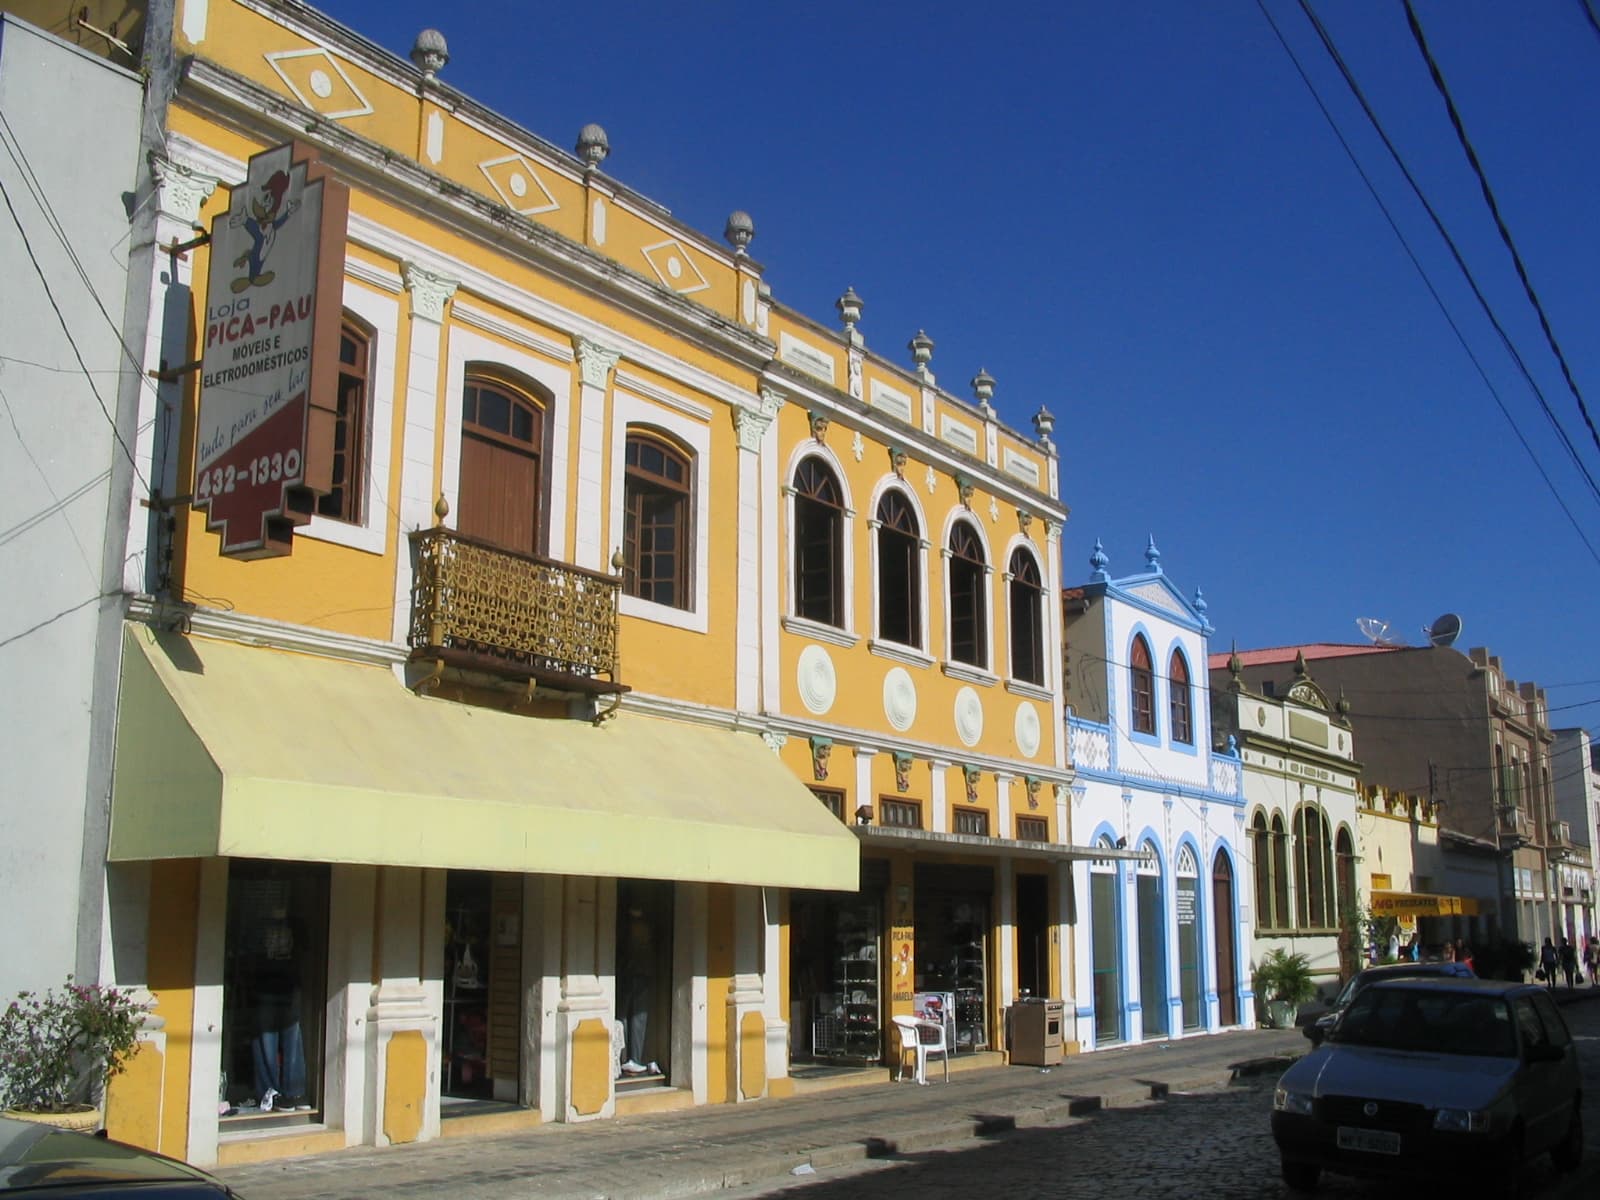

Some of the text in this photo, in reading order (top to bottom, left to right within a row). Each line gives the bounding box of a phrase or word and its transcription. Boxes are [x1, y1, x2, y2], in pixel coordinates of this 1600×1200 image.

[207, 294, 312, 349] PICA-PAU
[232, 335, 281, 361] MÓVEIS E
[200, 426, 225, 462] tudo
[230, 408, 257, 446] para
[199, 448, 301, 498] 432-1330
